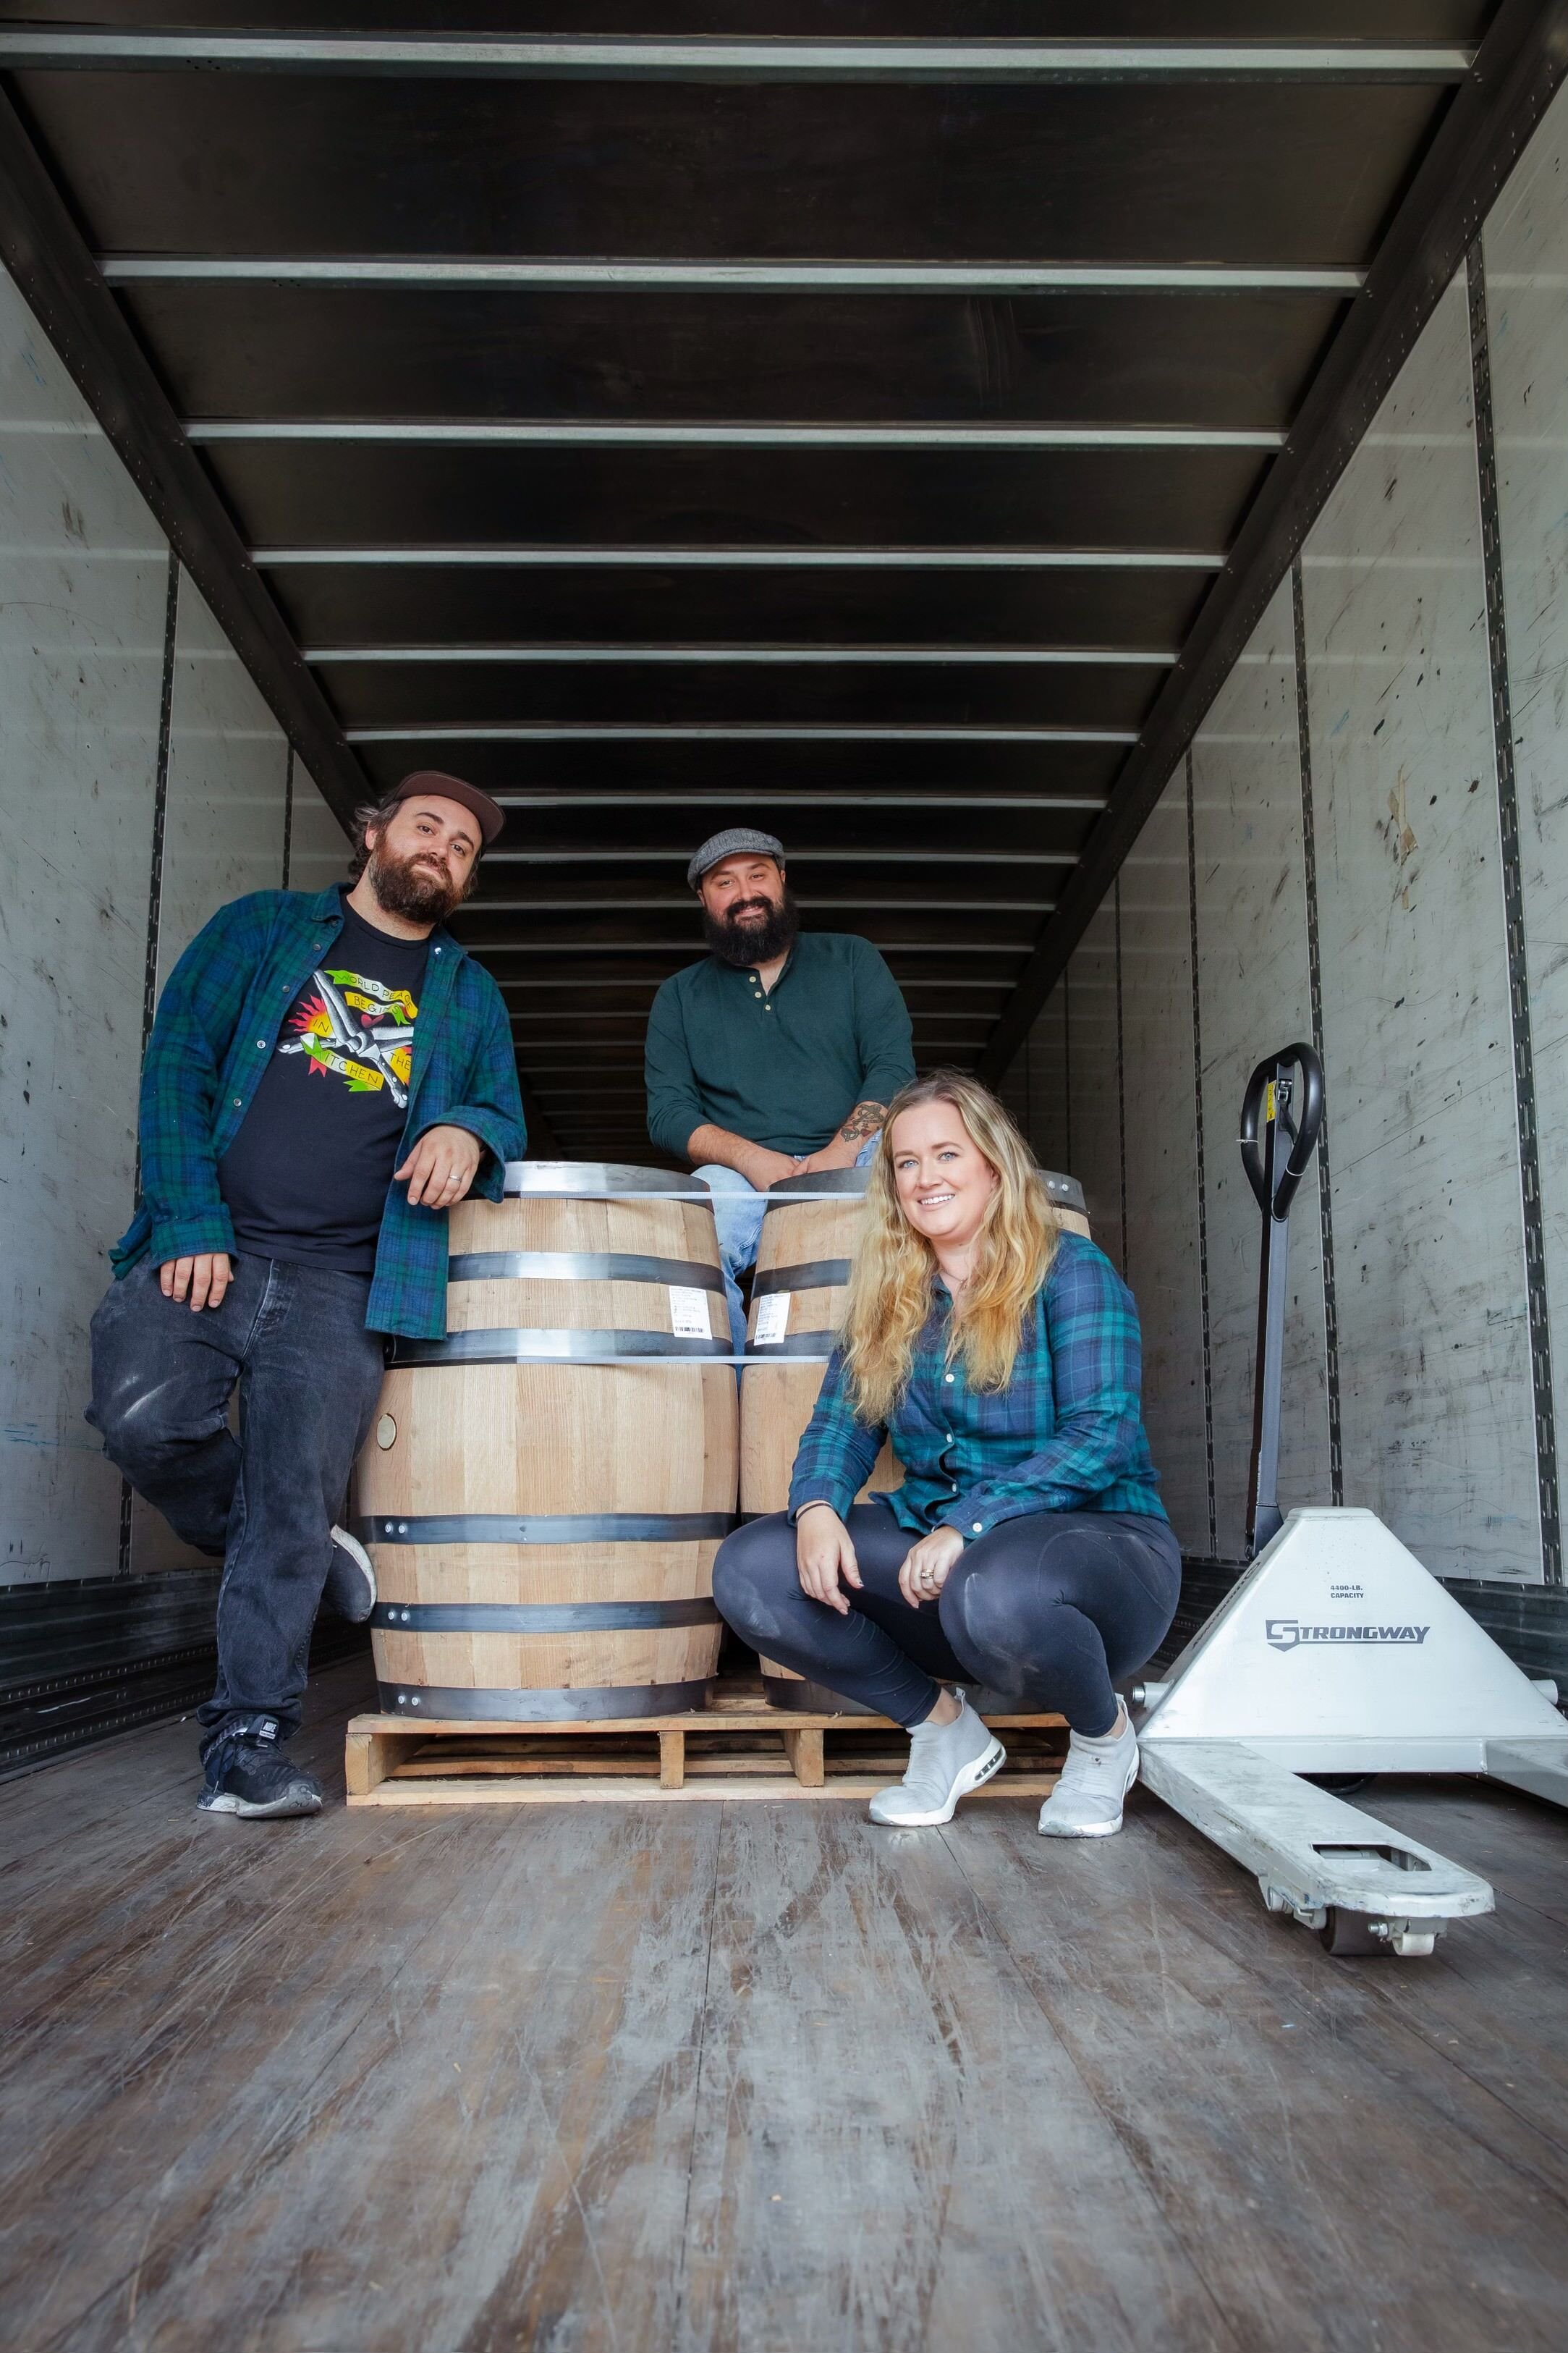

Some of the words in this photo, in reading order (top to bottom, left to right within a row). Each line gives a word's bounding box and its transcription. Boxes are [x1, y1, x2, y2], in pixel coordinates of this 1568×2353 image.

[335, 973, 380, 992] WORLD
[382, 989, 412, 1009] PEACE
[313, 1018, 330, 1033] IN
[389, 1052, 412, 1071] THE
[1265, 1619, 1431, 1652] STRONGWAY
